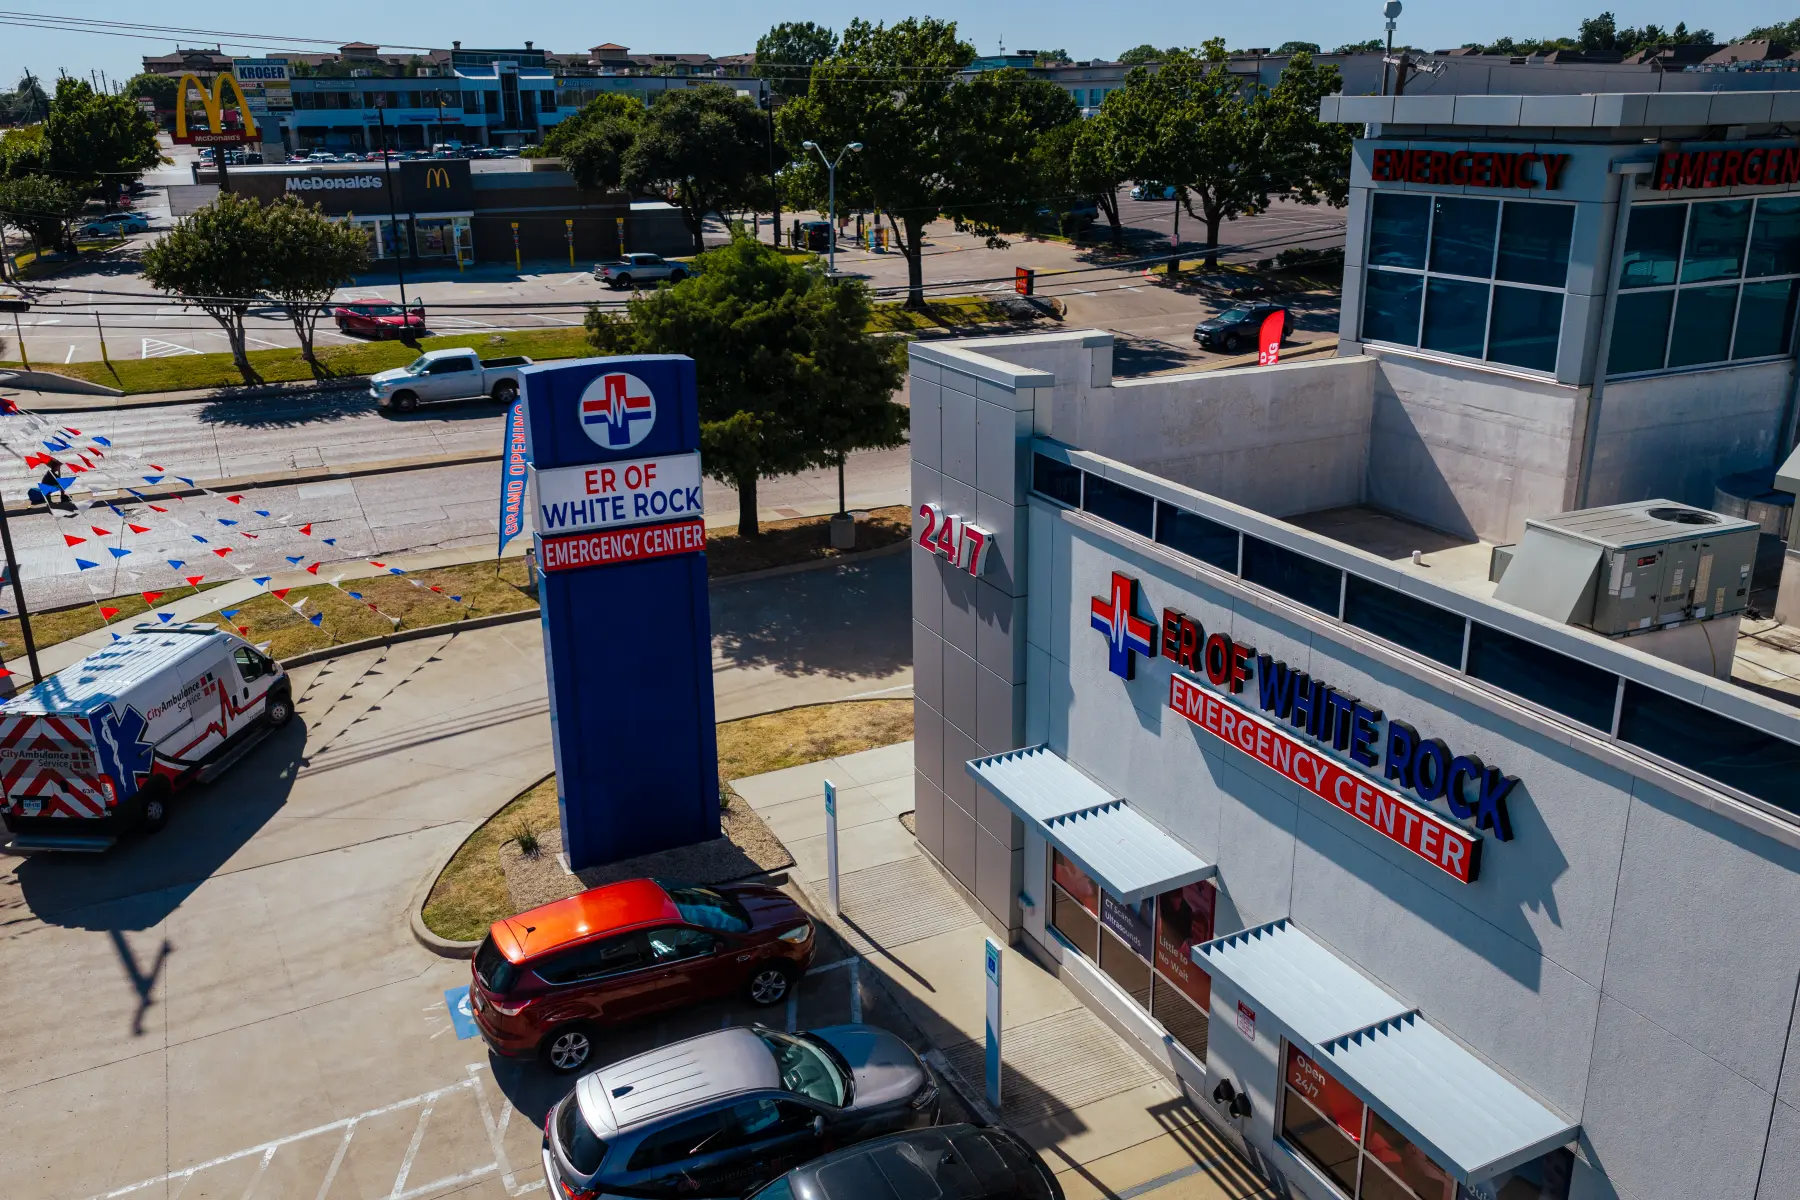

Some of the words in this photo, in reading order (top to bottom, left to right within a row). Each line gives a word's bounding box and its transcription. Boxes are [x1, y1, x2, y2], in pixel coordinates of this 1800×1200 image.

[239, 66, 286, 79] KROGER
[285, 176, 383, 191] McDonald's
[1371, 148, 1570, 191] EMERGENCY
[1655, 147, 1800, 191] EMERGEN
[584, 468, 617, 495] ER
[624, 463, 657, 490] OF
[505, 480, 524, 536] GRAND
[541, 495, 627, 528] WHITE
[633, 486, 702, 518] ROCK
[544, 532, 641, 567] EMERGENCY
[643, 524, 704, 555] CENTER
[919, 503, 990, 578] 24/7
[177, 692, 202, 713] Service
[1160, 606, 1205, 674] ER
[1204, 632, 1256, 695] OF
[1256, 652, 1383, 769] WHITE
[1384, 718, 1521, 842] ROCK
[38, 759, 69, 768] Service
[1171, 678, 1329, 793] EMERGENCY
[1333, 775, 1466, 876] CENTER
[1105, 898, 1114, 910] CT
[1104, 911, 1141, 947] Ultrasounds
[1159, 935, 1179, 957] Little
[1180, 952, 1189, 965] to
[1158, 951, 1169, 965] No
[1170, 960, 1189, 983] Wait
[1295, 1072, 1319, 1098] 24/7
[1296, 1054, 1326, 1086] Open
